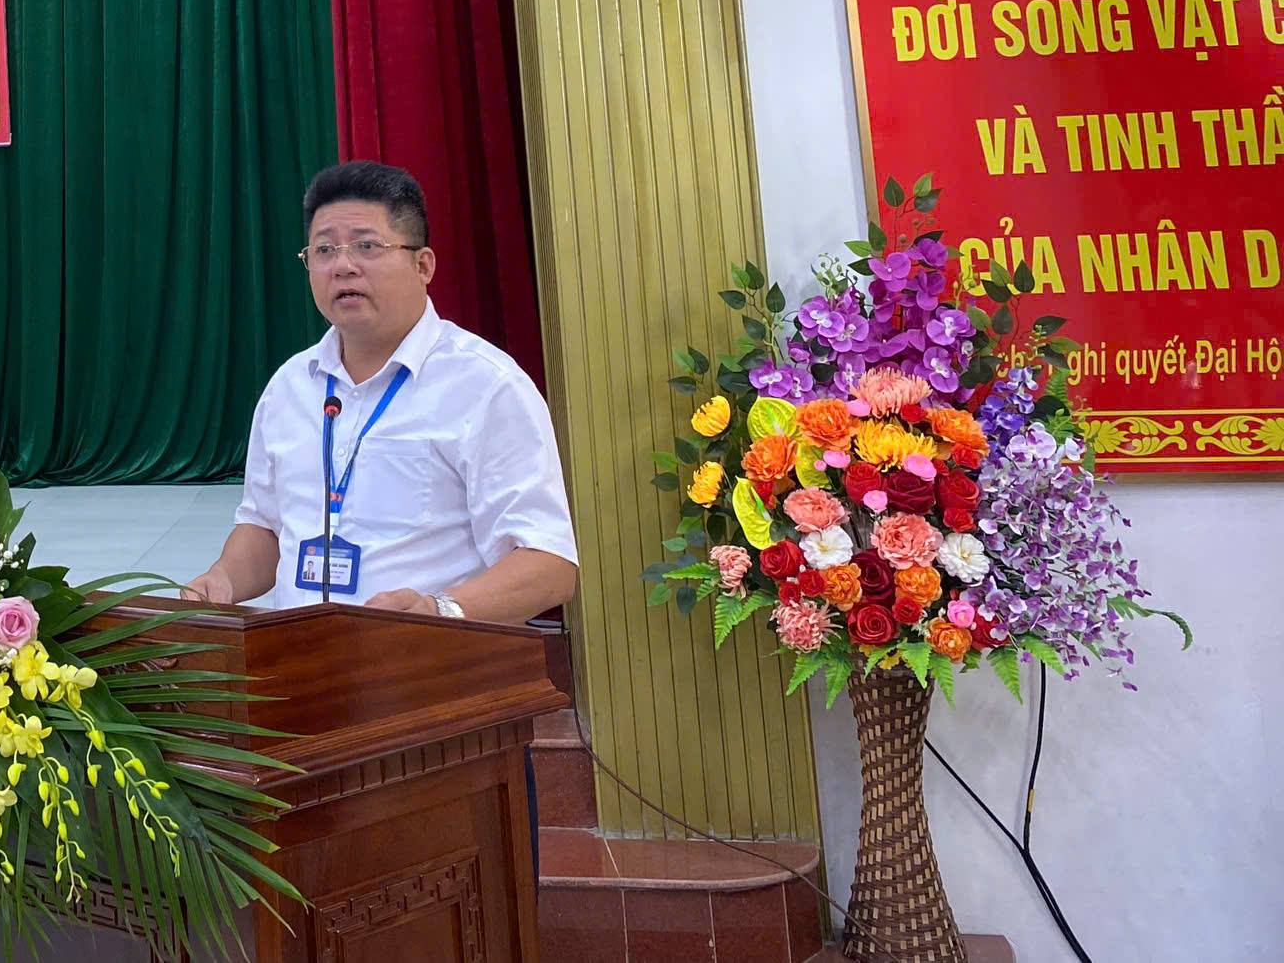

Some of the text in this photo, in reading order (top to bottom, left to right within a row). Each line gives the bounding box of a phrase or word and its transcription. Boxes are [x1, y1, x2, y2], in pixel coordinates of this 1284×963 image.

[976, 104, 1047, 175] VÀ
[1056, 111, 1180, 172] TINH
[1077, 219, 1230, 293] NHÂN
[1048, 341, 1107, 386] ghị
[1115, 335, 1187, 383] quyết
[1195, 339, 1236, 381] Đại
